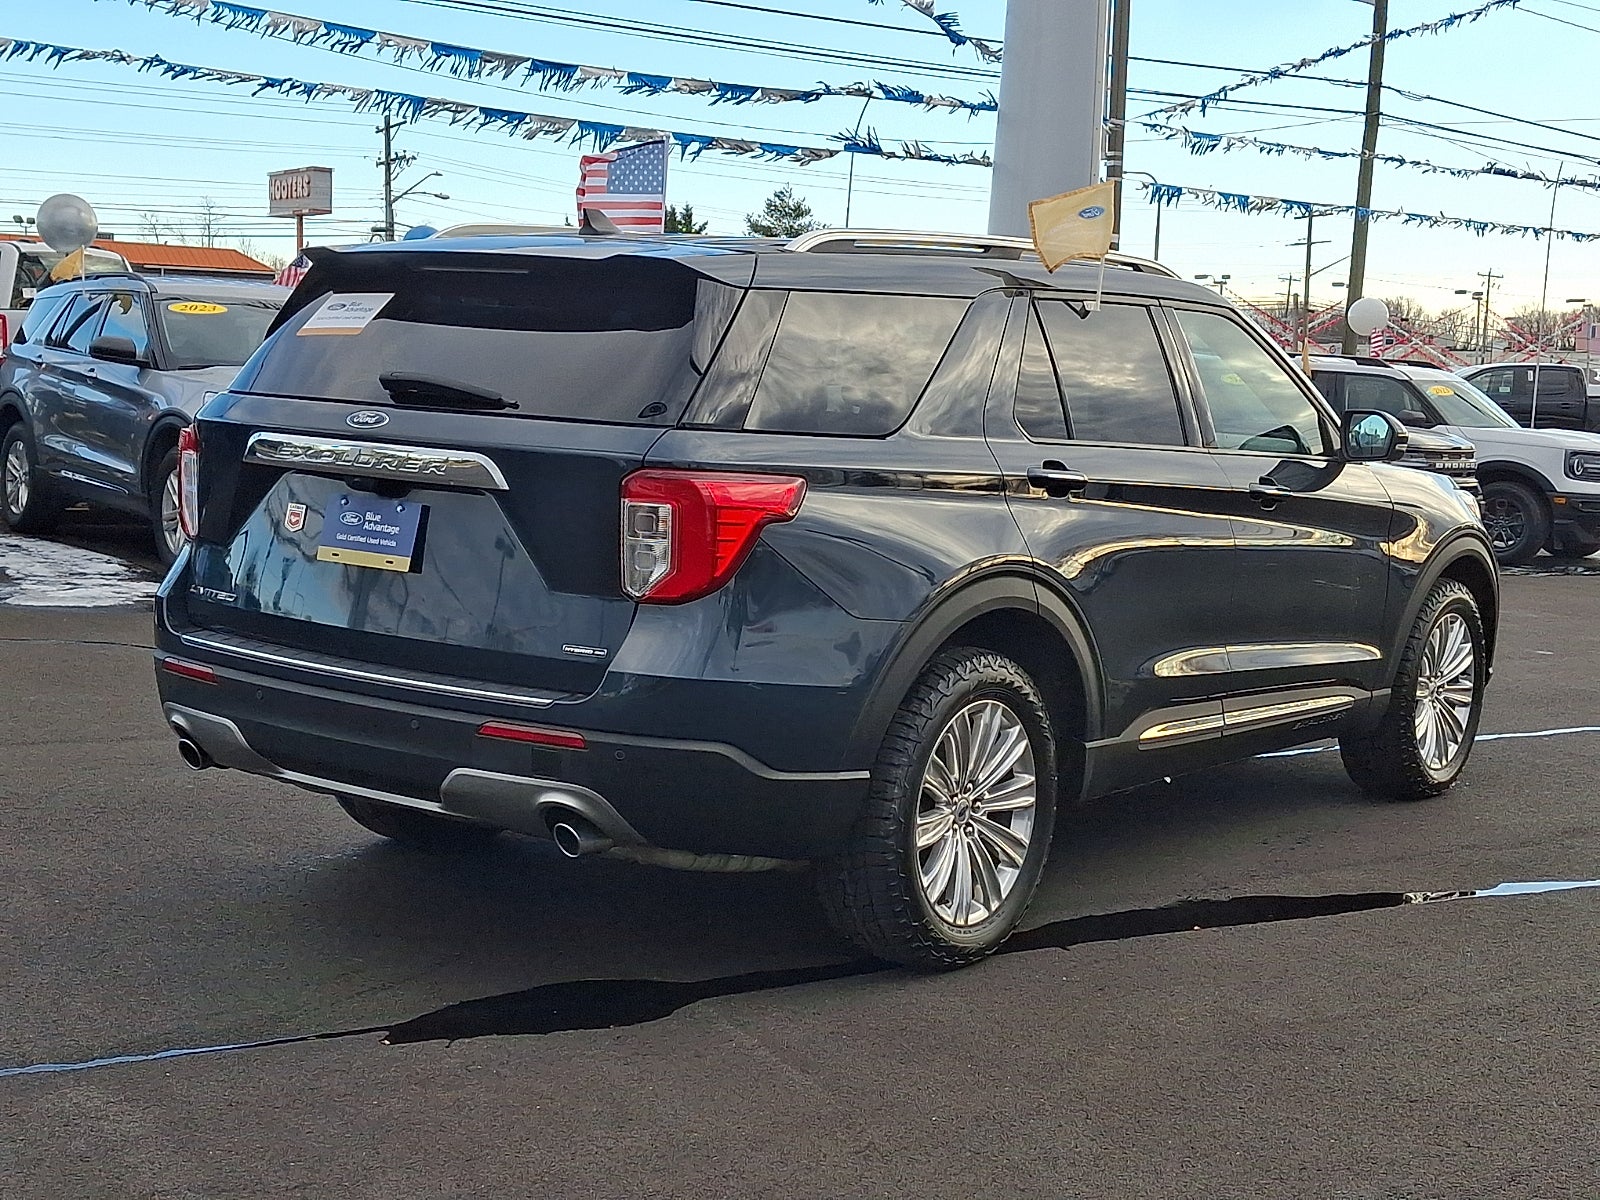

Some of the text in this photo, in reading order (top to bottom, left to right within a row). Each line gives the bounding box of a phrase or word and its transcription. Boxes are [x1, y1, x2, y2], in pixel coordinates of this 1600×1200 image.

[180, 304, 217, 312] 2023
[276, 443, 446, 475] EXPLORER
[365, 511, 382, 522] Blue
[363, 521, 400, 535] Advantage
[336, 532, 397, 547] Gold Certified Used Vehicle
